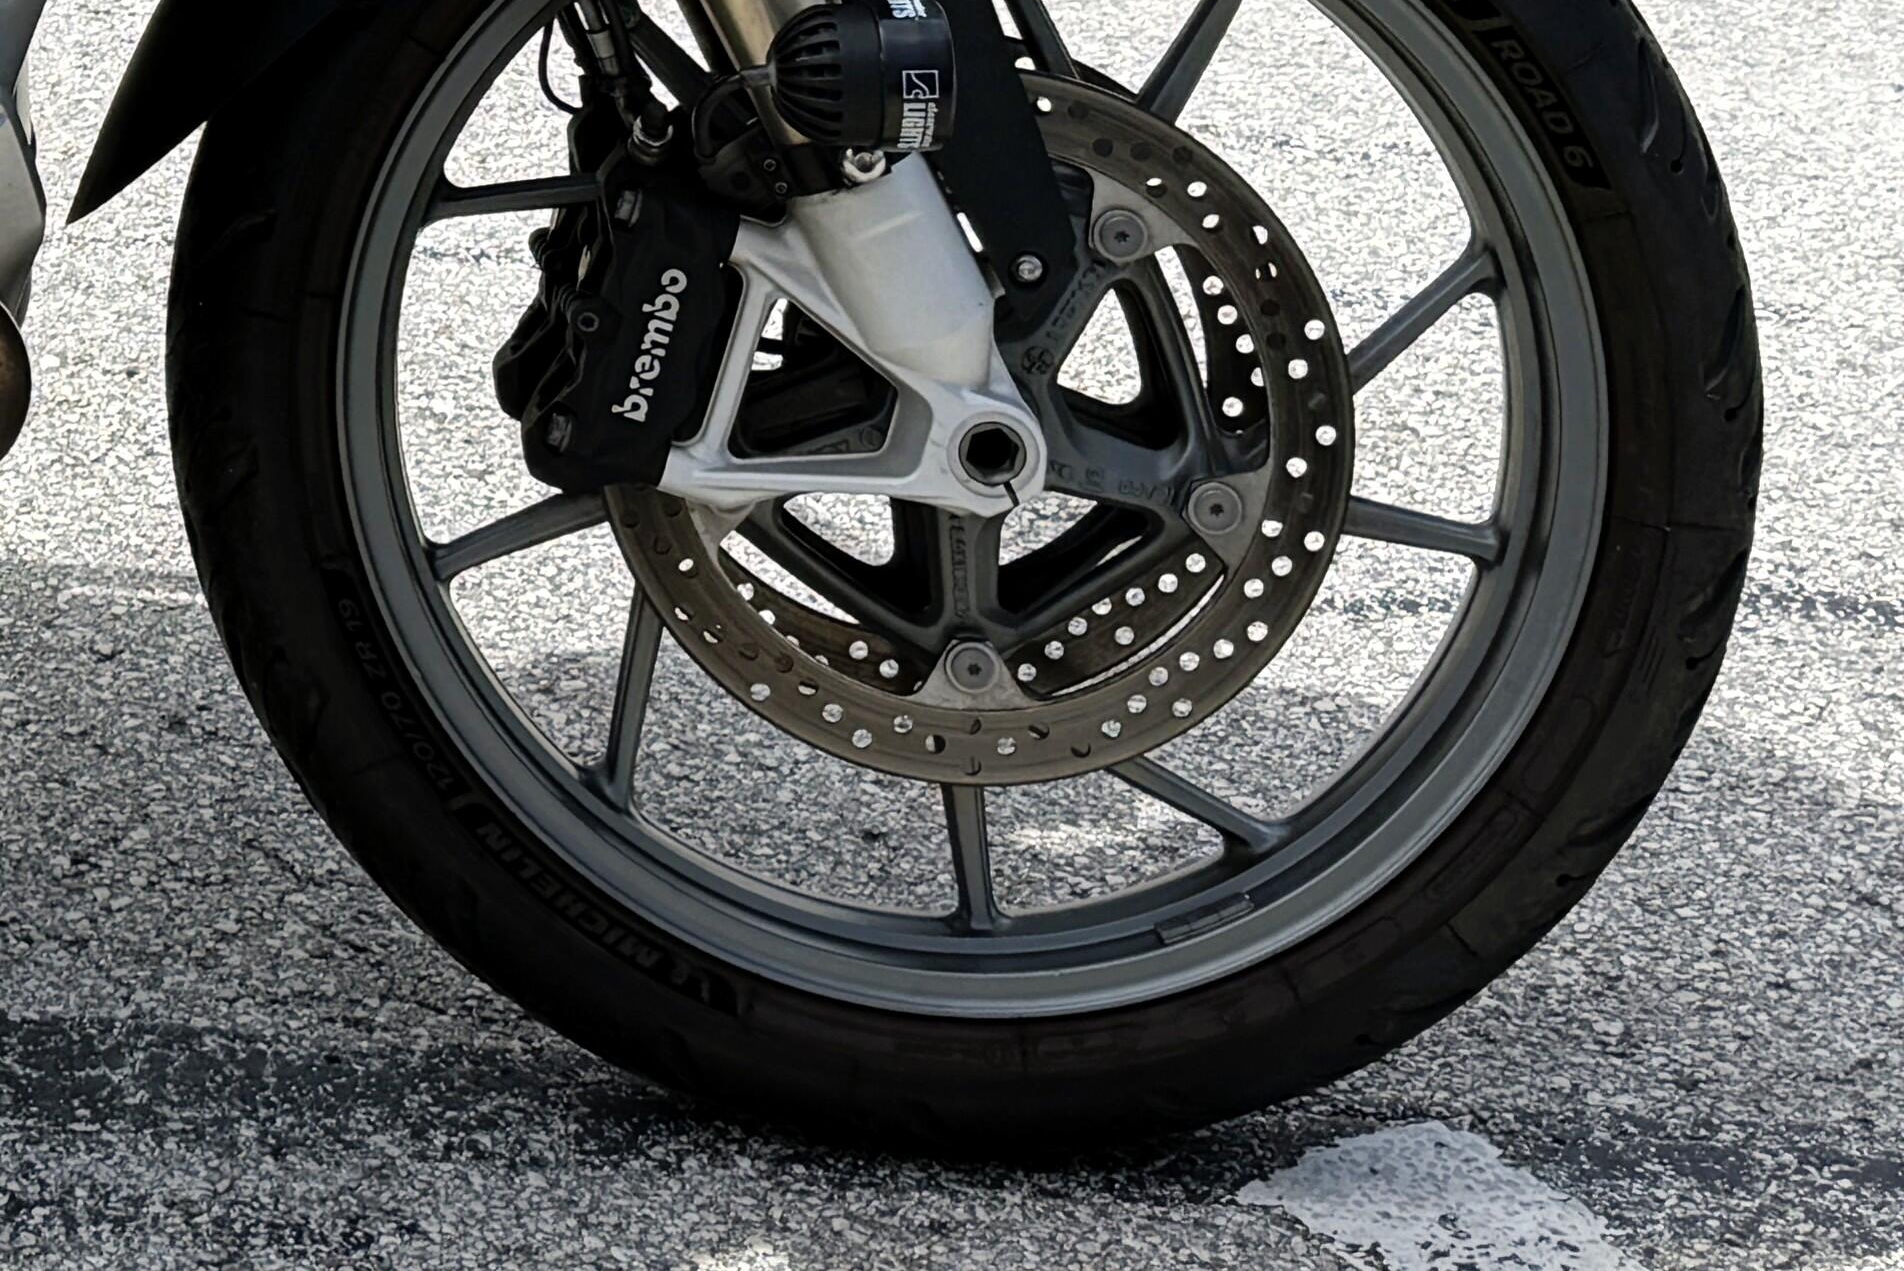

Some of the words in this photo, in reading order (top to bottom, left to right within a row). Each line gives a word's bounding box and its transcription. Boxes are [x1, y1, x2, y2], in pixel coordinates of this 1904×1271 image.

[896, 102, 927, 148] LIGHTS
[1492, 37, 1574, 139] ROAD
[1560, 137, 1593, 175] 6
[611, 267, 688, 423] brembo
[475, 817, 664, 972] MICHELIN
